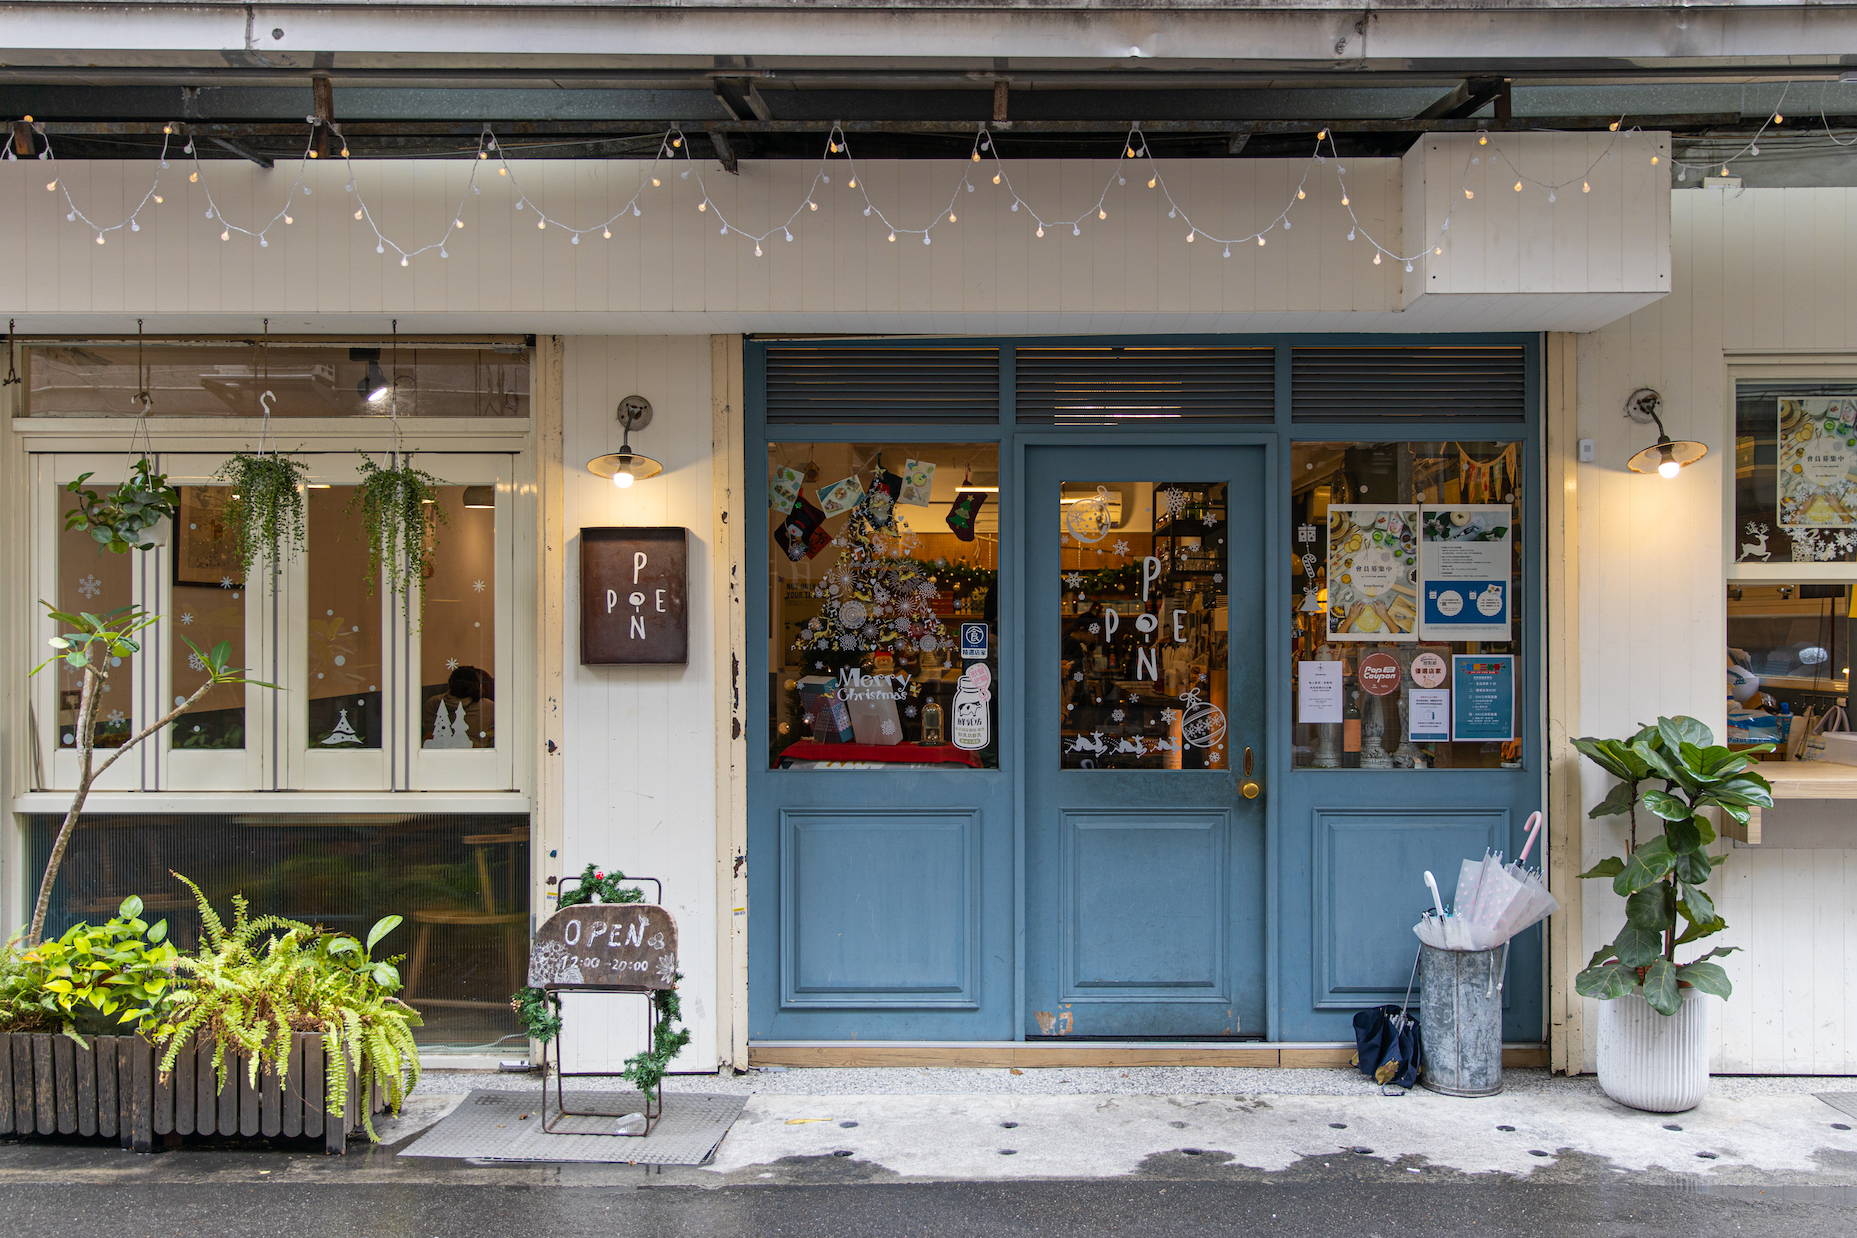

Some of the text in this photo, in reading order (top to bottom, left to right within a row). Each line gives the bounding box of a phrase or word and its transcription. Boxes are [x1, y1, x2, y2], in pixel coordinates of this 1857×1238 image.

[786, 582, 800, 590] NOT
[1364, 666, 1383, 674] Pop
[835, 667, 912, 692] Merry
[1363, 672, 1396, 683] Coupon
[837, 688, 908, 702] Christmas
[957, 718, 983, 727] 鮮乳坊
[563, 918, 648, 949] OPEN
